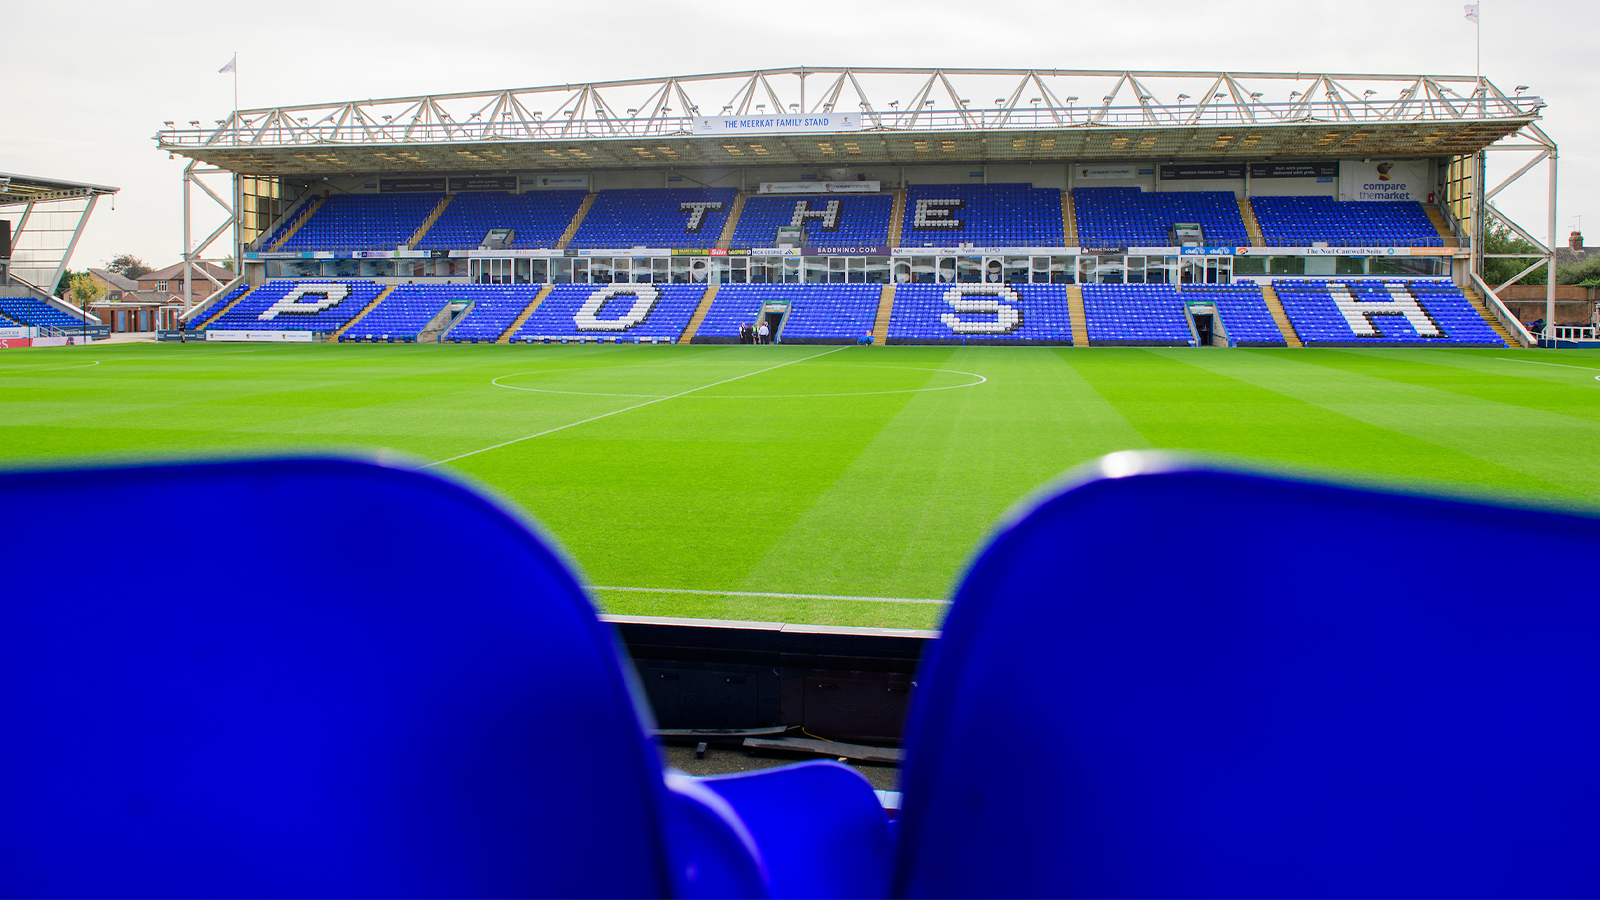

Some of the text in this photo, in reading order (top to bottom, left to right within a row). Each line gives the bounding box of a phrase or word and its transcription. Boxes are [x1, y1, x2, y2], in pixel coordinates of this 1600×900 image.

[724, 117, 829, 129] THE MEERKAT FAMILY STAND
[1363, 183, 1406, 192] compare
[1359, 191, 1410, 200] themarket
